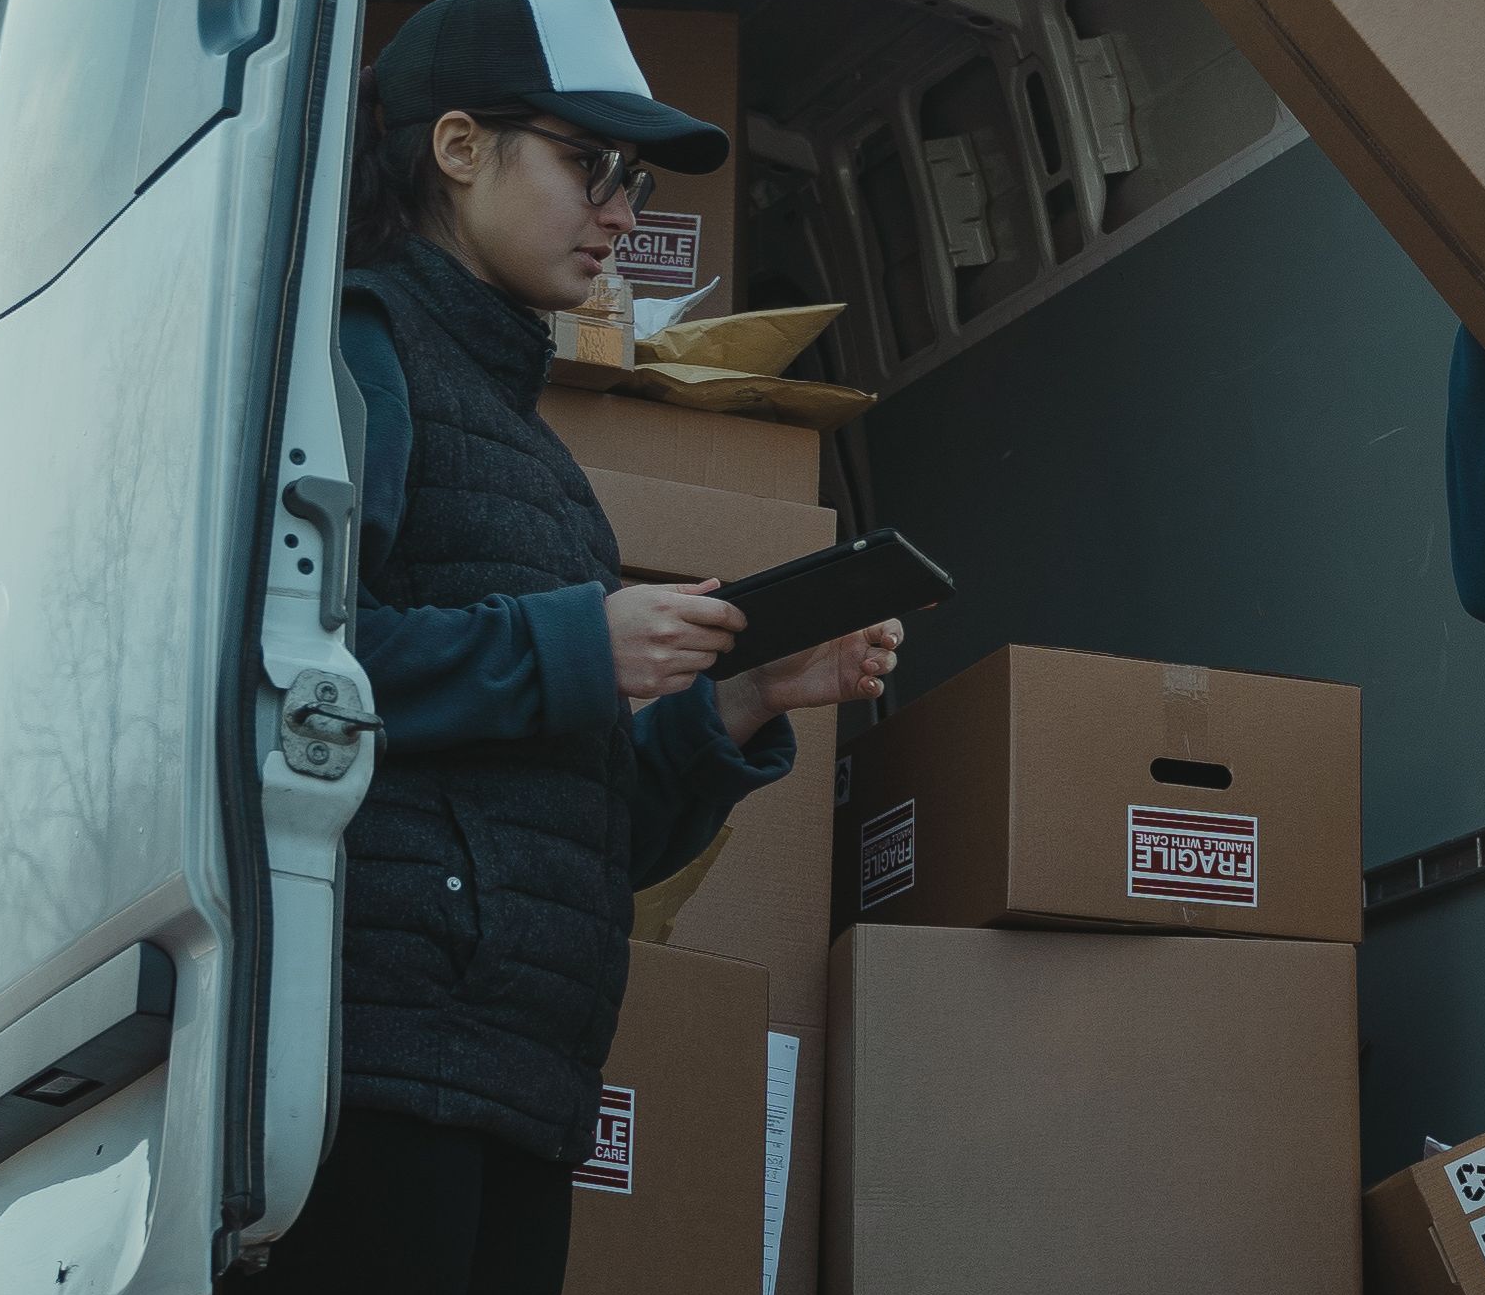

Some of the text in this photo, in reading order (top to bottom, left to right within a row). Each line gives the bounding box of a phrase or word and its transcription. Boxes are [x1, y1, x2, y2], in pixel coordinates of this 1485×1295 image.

[615, 233, 693, 257] AGILE
[629, 253, 657, 264] WITH
[660, 255, 691, 267] CARE
[1135, 833, 1252, 854] HANDLE WITH CARE
[864, 838, 912, 880] FRAGILE
[1135, 845, 1252, 878] FRAGILE
[595, 1146, 627, 1162] CARE
